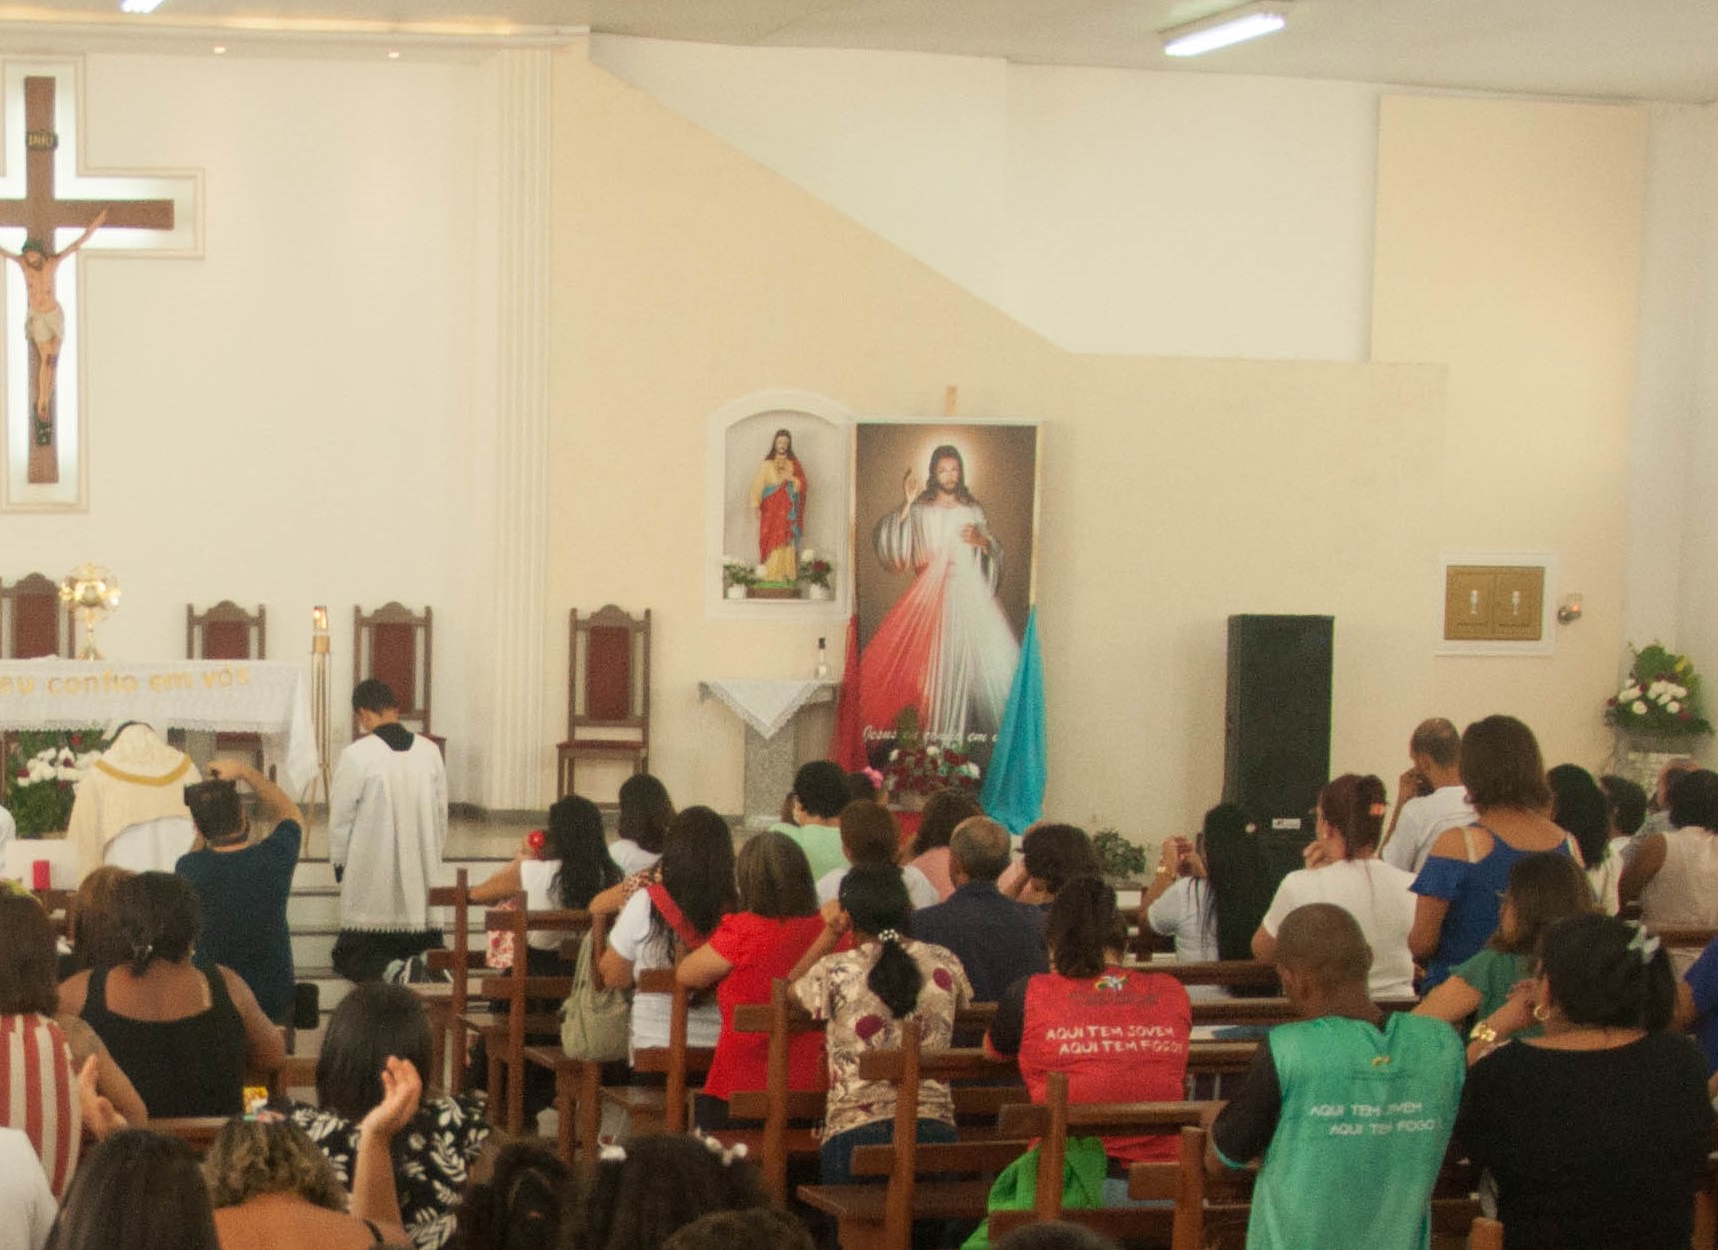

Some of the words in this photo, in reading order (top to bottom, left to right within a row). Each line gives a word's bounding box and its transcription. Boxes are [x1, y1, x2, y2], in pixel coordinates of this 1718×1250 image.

[47, 668, 139, 696] confio
[148, 669, 192, 692] em
[1046, 1027, 1084, 1040] AQUI
[1087, 1025, 1123, 1037] TEM
[1127, 1025, 1175, 1037] JOVEM
[1059, 1041, 1098, 1055] AQUI
[1102, 1040, 1138, 1052] TEM
